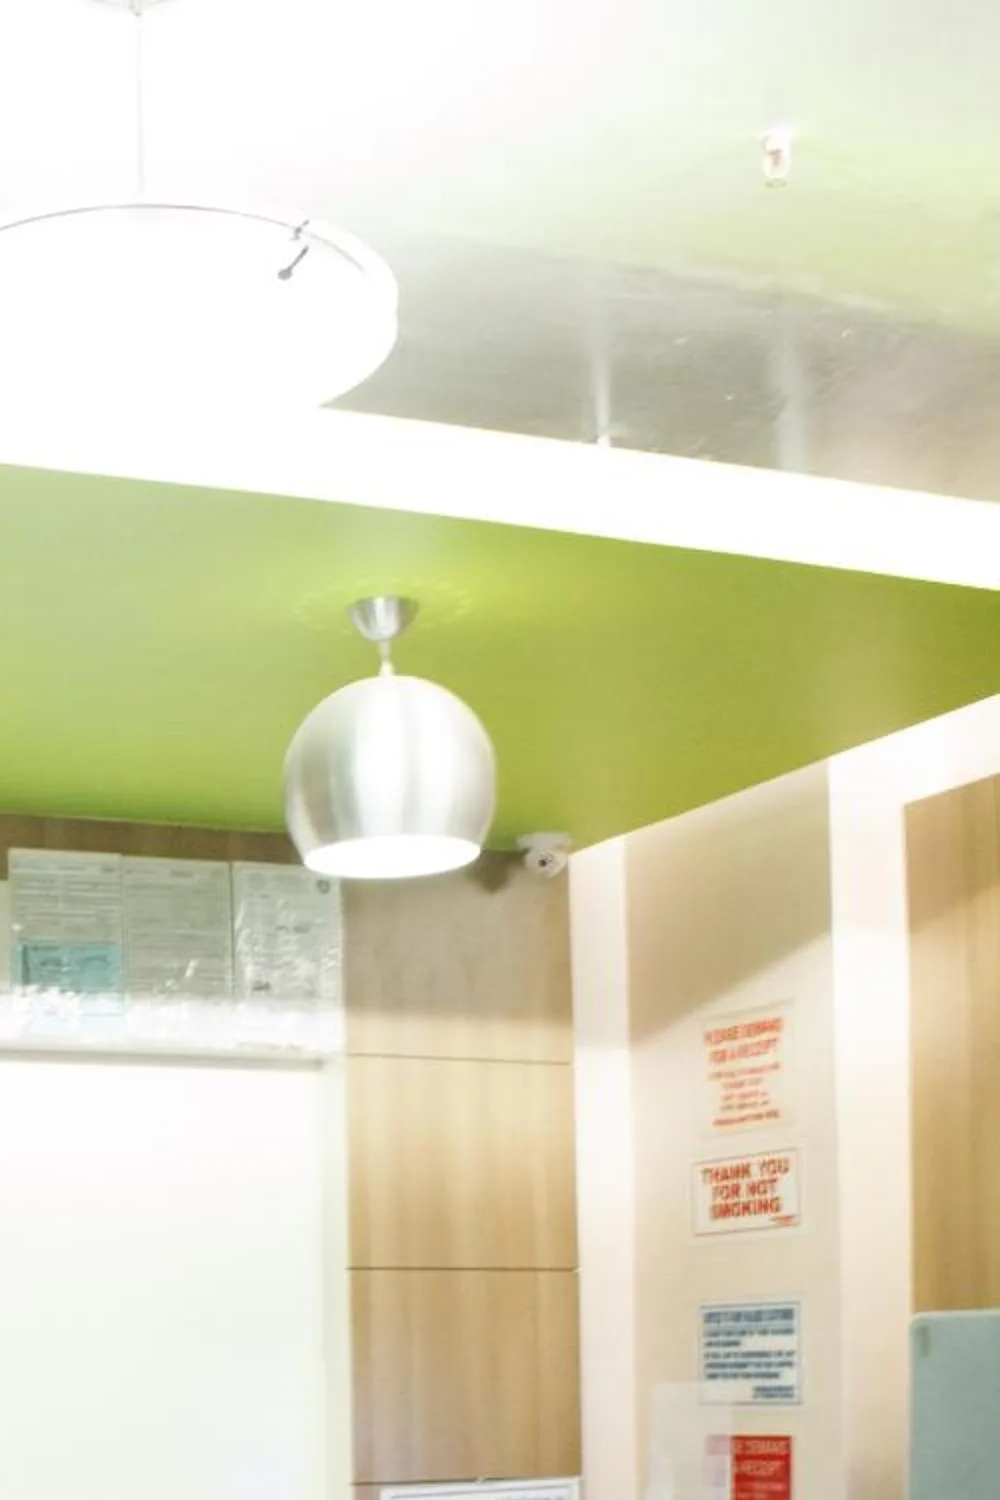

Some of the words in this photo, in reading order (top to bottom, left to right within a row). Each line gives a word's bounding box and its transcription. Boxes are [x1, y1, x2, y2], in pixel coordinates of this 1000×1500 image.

[701, 1162, 751, 1184] THANK
[759, 1157, 790, 1177] YOU
[711, 1182, 741, 1202] FOR
[746, 1178, 778, 1199] NOT
[709, 1196, 782, 1221] SMOKING
